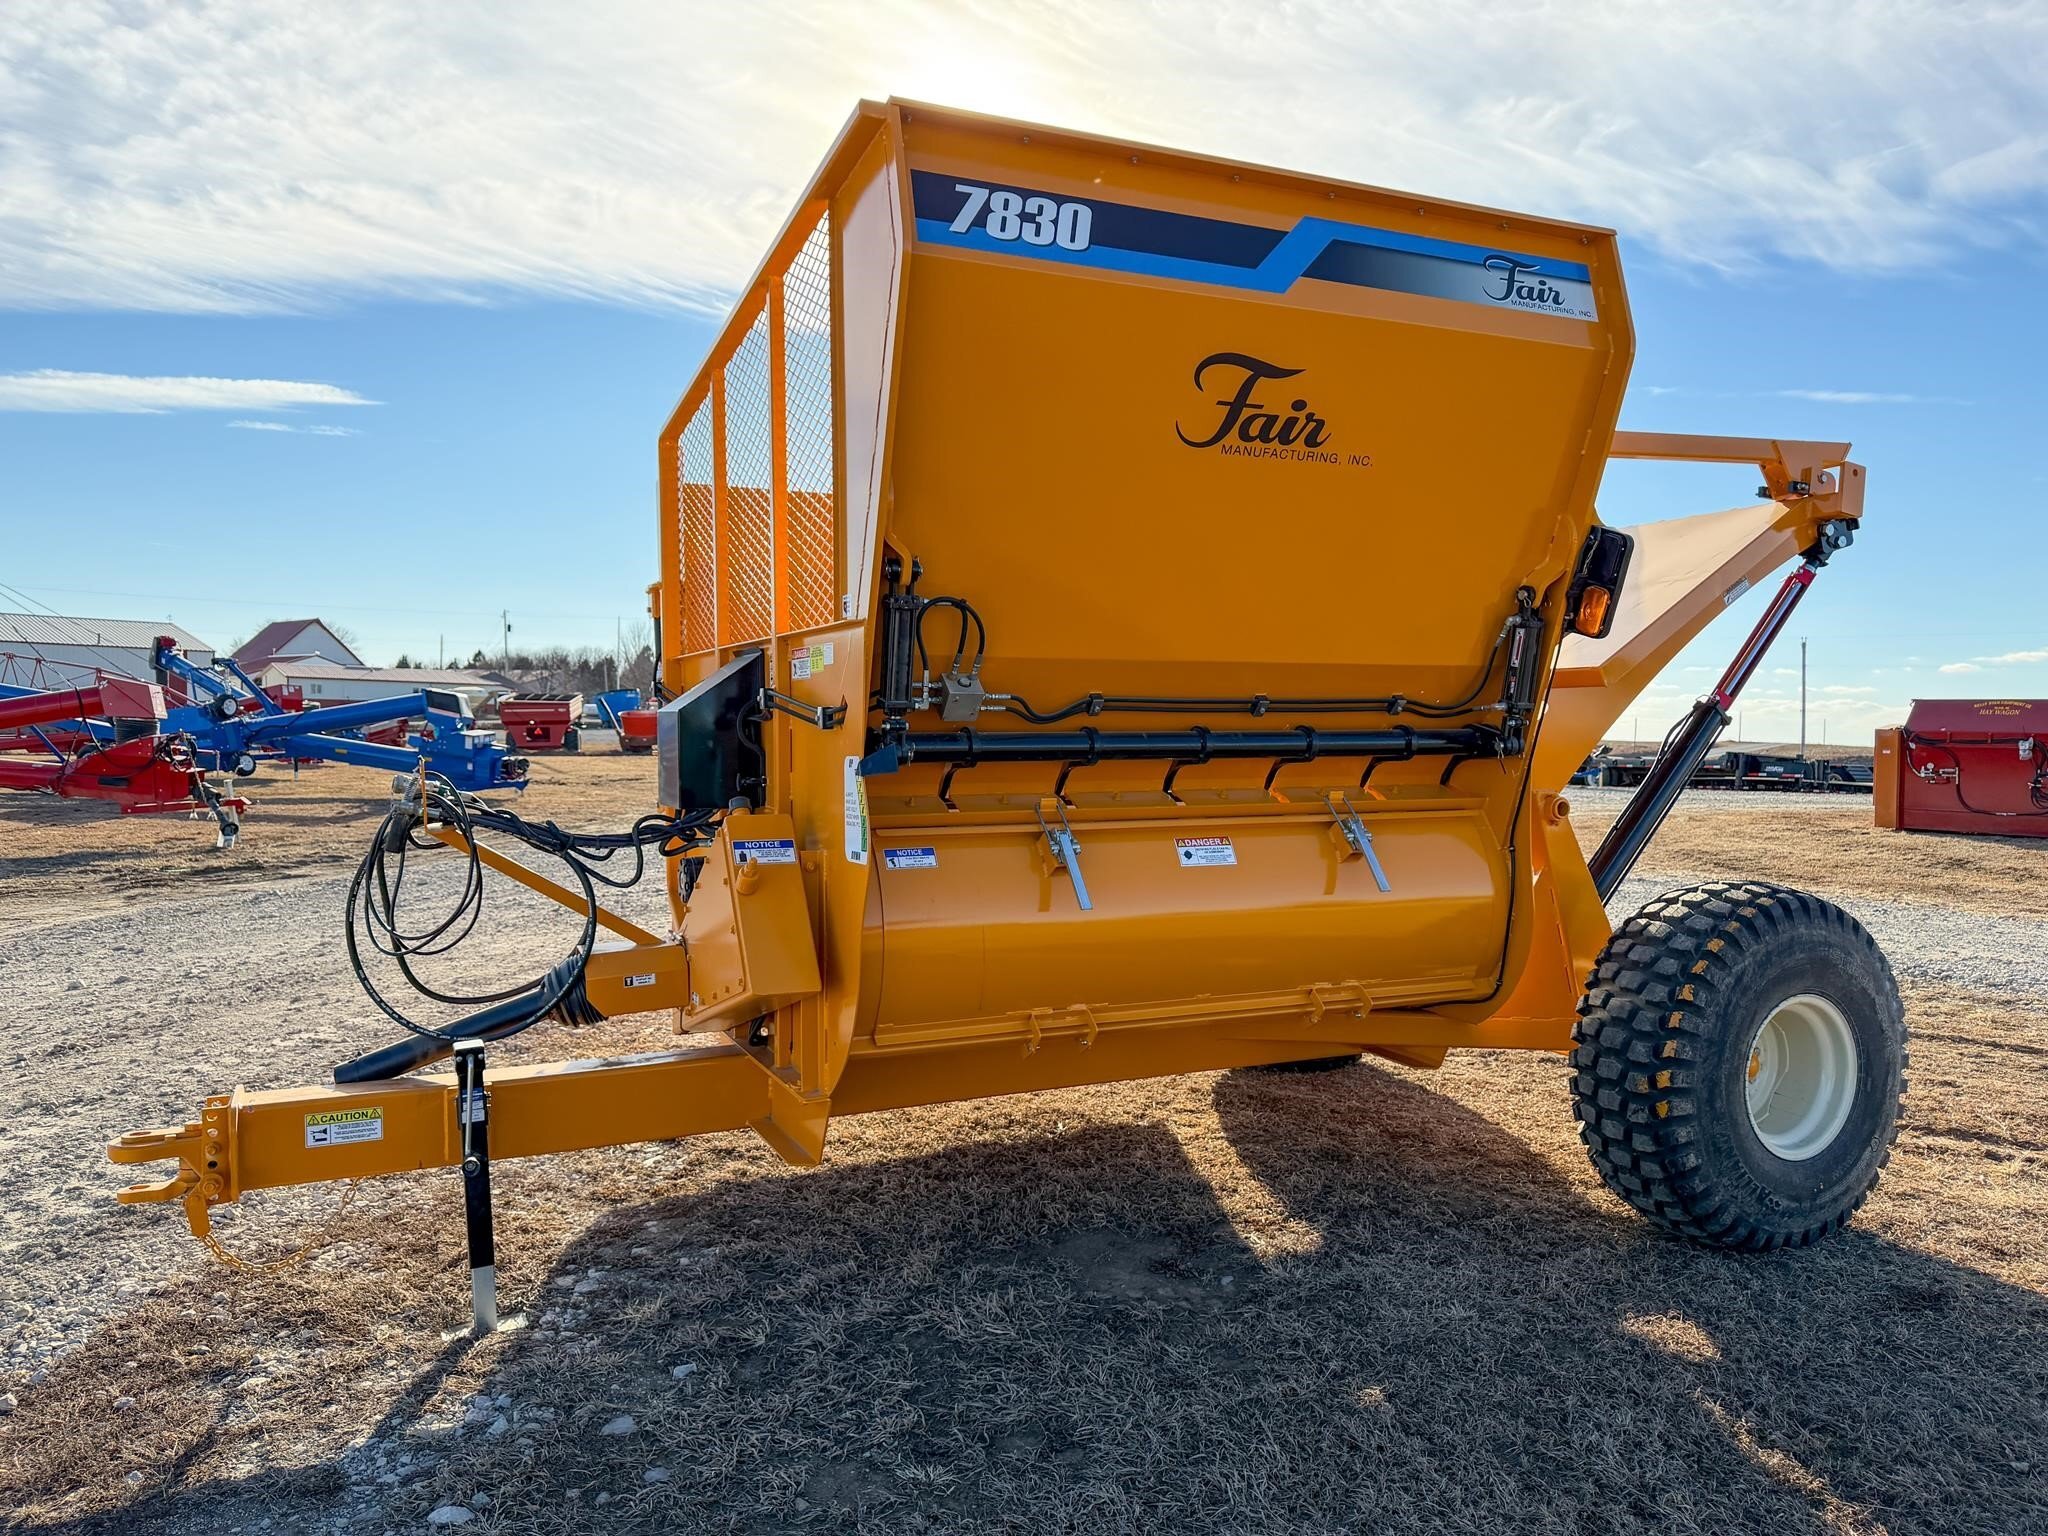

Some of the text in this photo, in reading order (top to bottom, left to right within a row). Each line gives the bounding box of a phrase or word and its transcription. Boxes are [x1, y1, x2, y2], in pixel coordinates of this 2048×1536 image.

[949, 183, 1093, 251] 7830
[1481, 254, 1566, 306] Fair
[1510, 300, 1594, 318] MANUFACTURING, INC.
[1175, 352, 1332, 449] Fair
[1220, 444, 1373, 467] MANUFACTURING, INC.
[1184, 838, 1222, 846] DANGER
[896, 848, 923, 857] NOTICE
[320, 1111, 369, 1123] CAUTION
